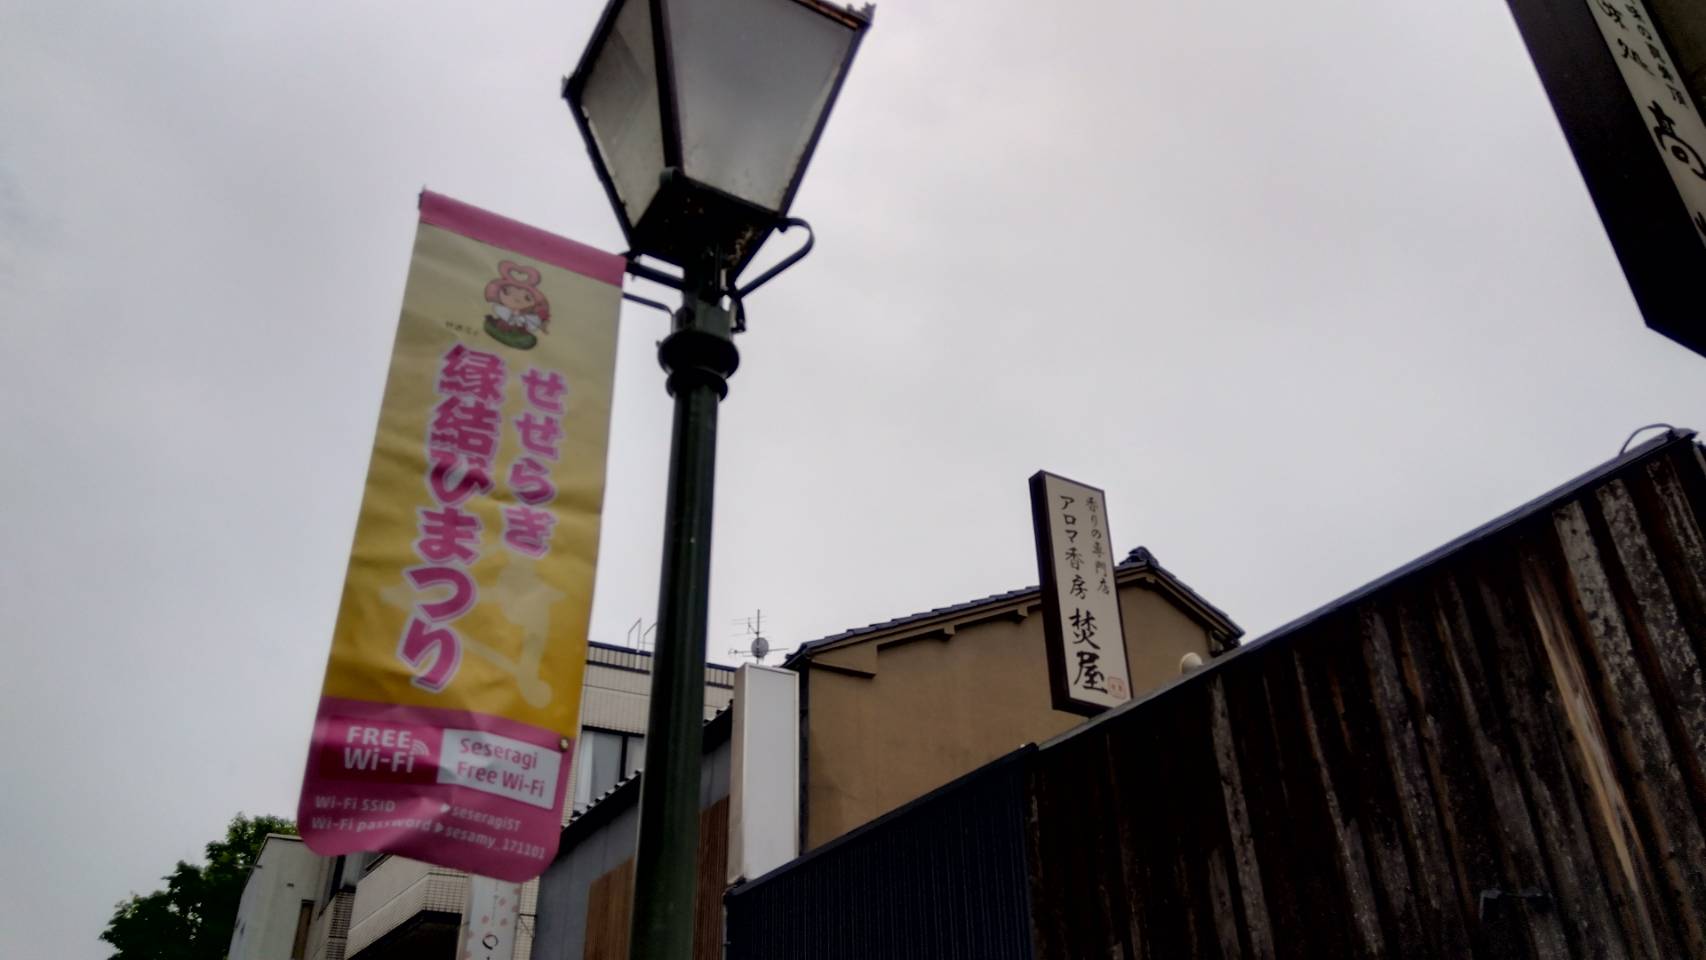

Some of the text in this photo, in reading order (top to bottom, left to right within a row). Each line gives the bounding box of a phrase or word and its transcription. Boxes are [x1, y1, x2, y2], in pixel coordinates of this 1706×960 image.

[503, 366, 569, 560] せせらぎ
[400, 342, 508, 692] 縁結びまつり
[346, 725, 412, 749] FREE
[343, 748, 416, 774] Wi-Fi
[460, 737, 538, 770] Seseragi
[457, 761, 545, 798] Free Wi-Fi
[315, 795, 396, 813] Wi-Fi SSID
[311, 816, 433, 833] Wi-Fi password
